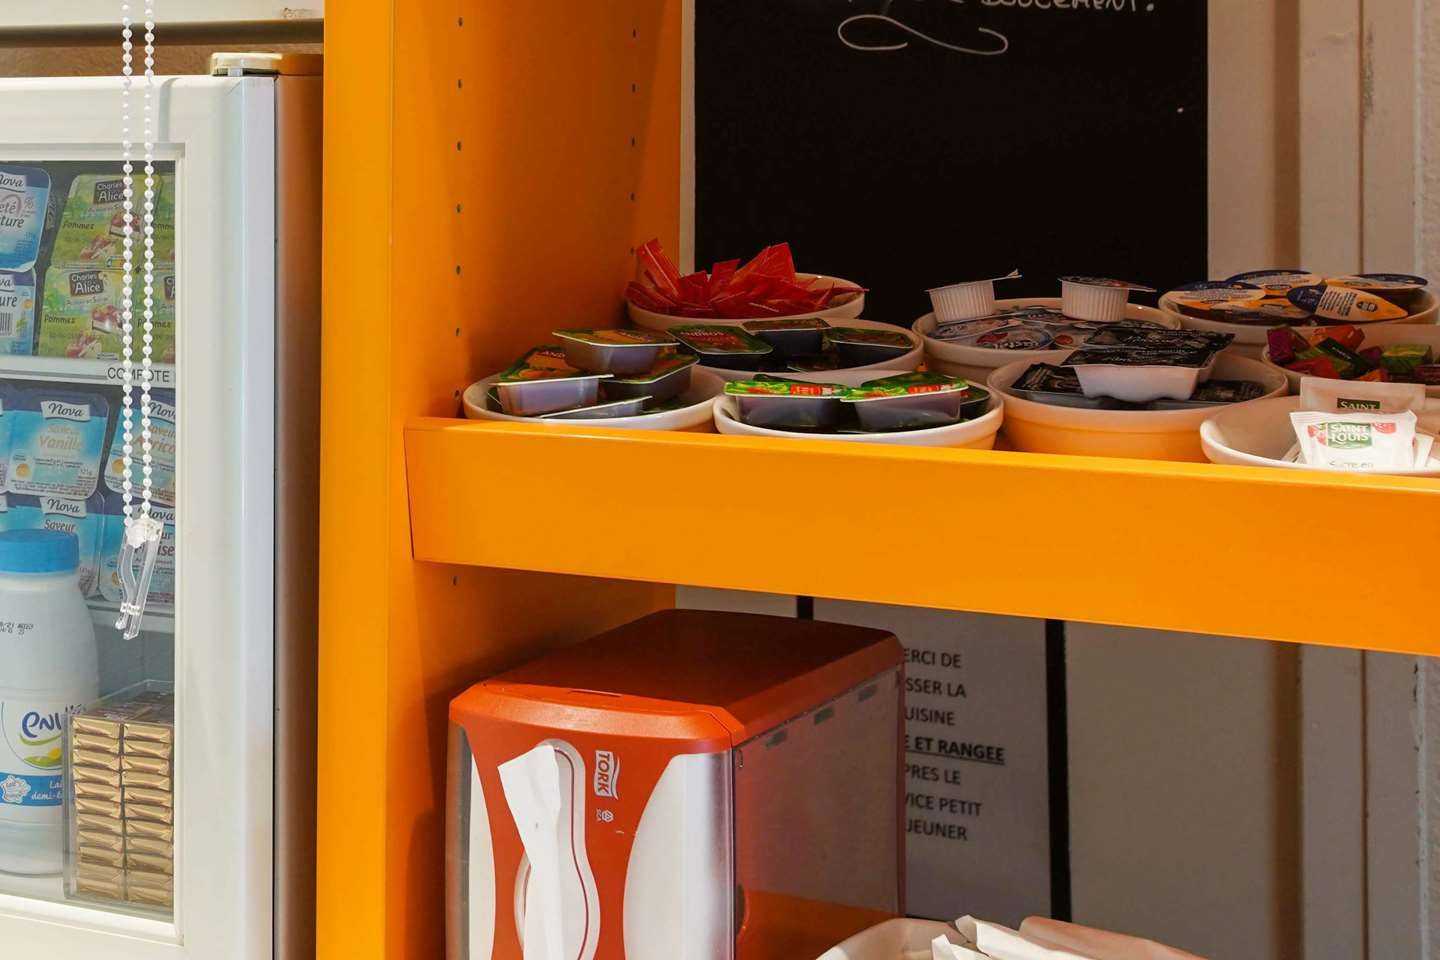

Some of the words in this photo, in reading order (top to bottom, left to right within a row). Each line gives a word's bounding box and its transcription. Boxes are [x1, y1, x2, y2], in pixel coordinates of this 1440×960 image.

[74, 282, 102, 294] Alice
[44, 314, 76, 323] Pommes
[48, 402, 84, 417] Nova
[1330, 423, 1369, 432] SAINT
[1330, 431, 1370, 445] LOUIS
[46, 498, 81, 513] Nova
[903, 648, 936, 666] ERCI
[941, 653, 961, 669] DE
[905, 677, 942, 695] SSER
[947, 682, 967, 699] LA
[905, 706, 956, 726] UISINE
[914, 736, 934, 752] ET
[937, 739, 1005, 762] RANGEE
[598, 752, 611, 795] TORK
[944, 768, 961, 785] LE
[939, 797, 983, 817] PETIT
